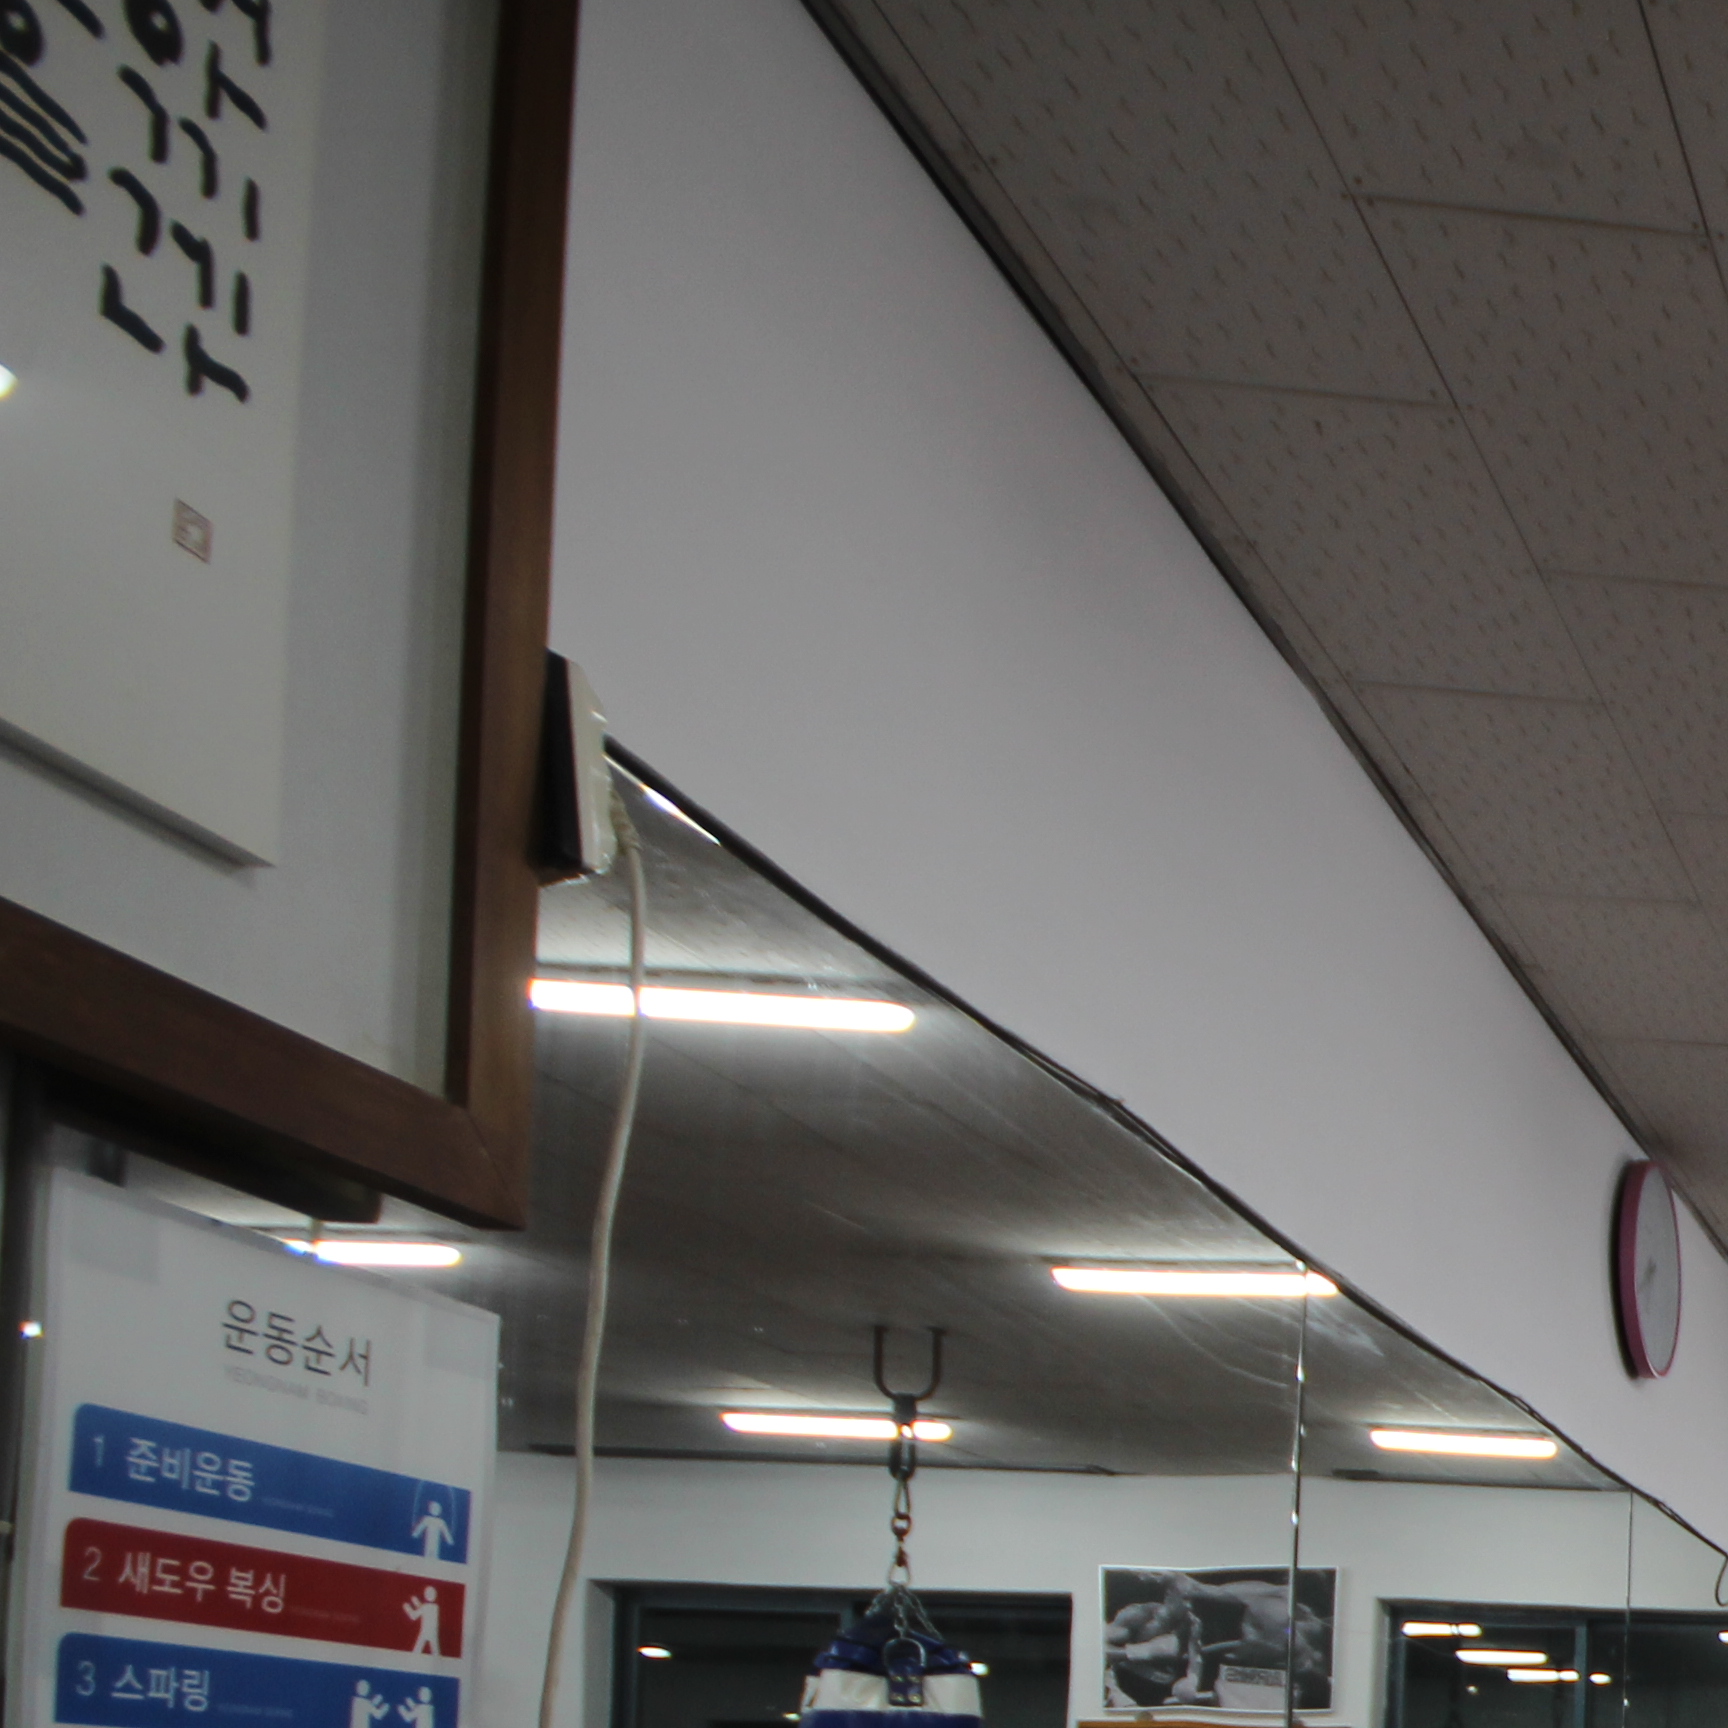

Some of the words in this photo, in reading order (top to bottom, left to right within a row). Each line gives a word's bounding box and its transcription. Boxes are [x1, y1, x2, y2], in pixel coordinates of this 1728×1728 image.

[221, 1299, 372, 1387] 운동순서
[92, 1433, 106, 1468] 1
[125, 1436, 257, 1504] 준비운동
[82, 1546, 103, 1582] 2
[118, 1551, 216, 1603] 새도우
[226, 1566, 287, 1614] 복싱
[75, 1660, 97, 1697] 3
[111, 1664, 211, 1713] 스파링
